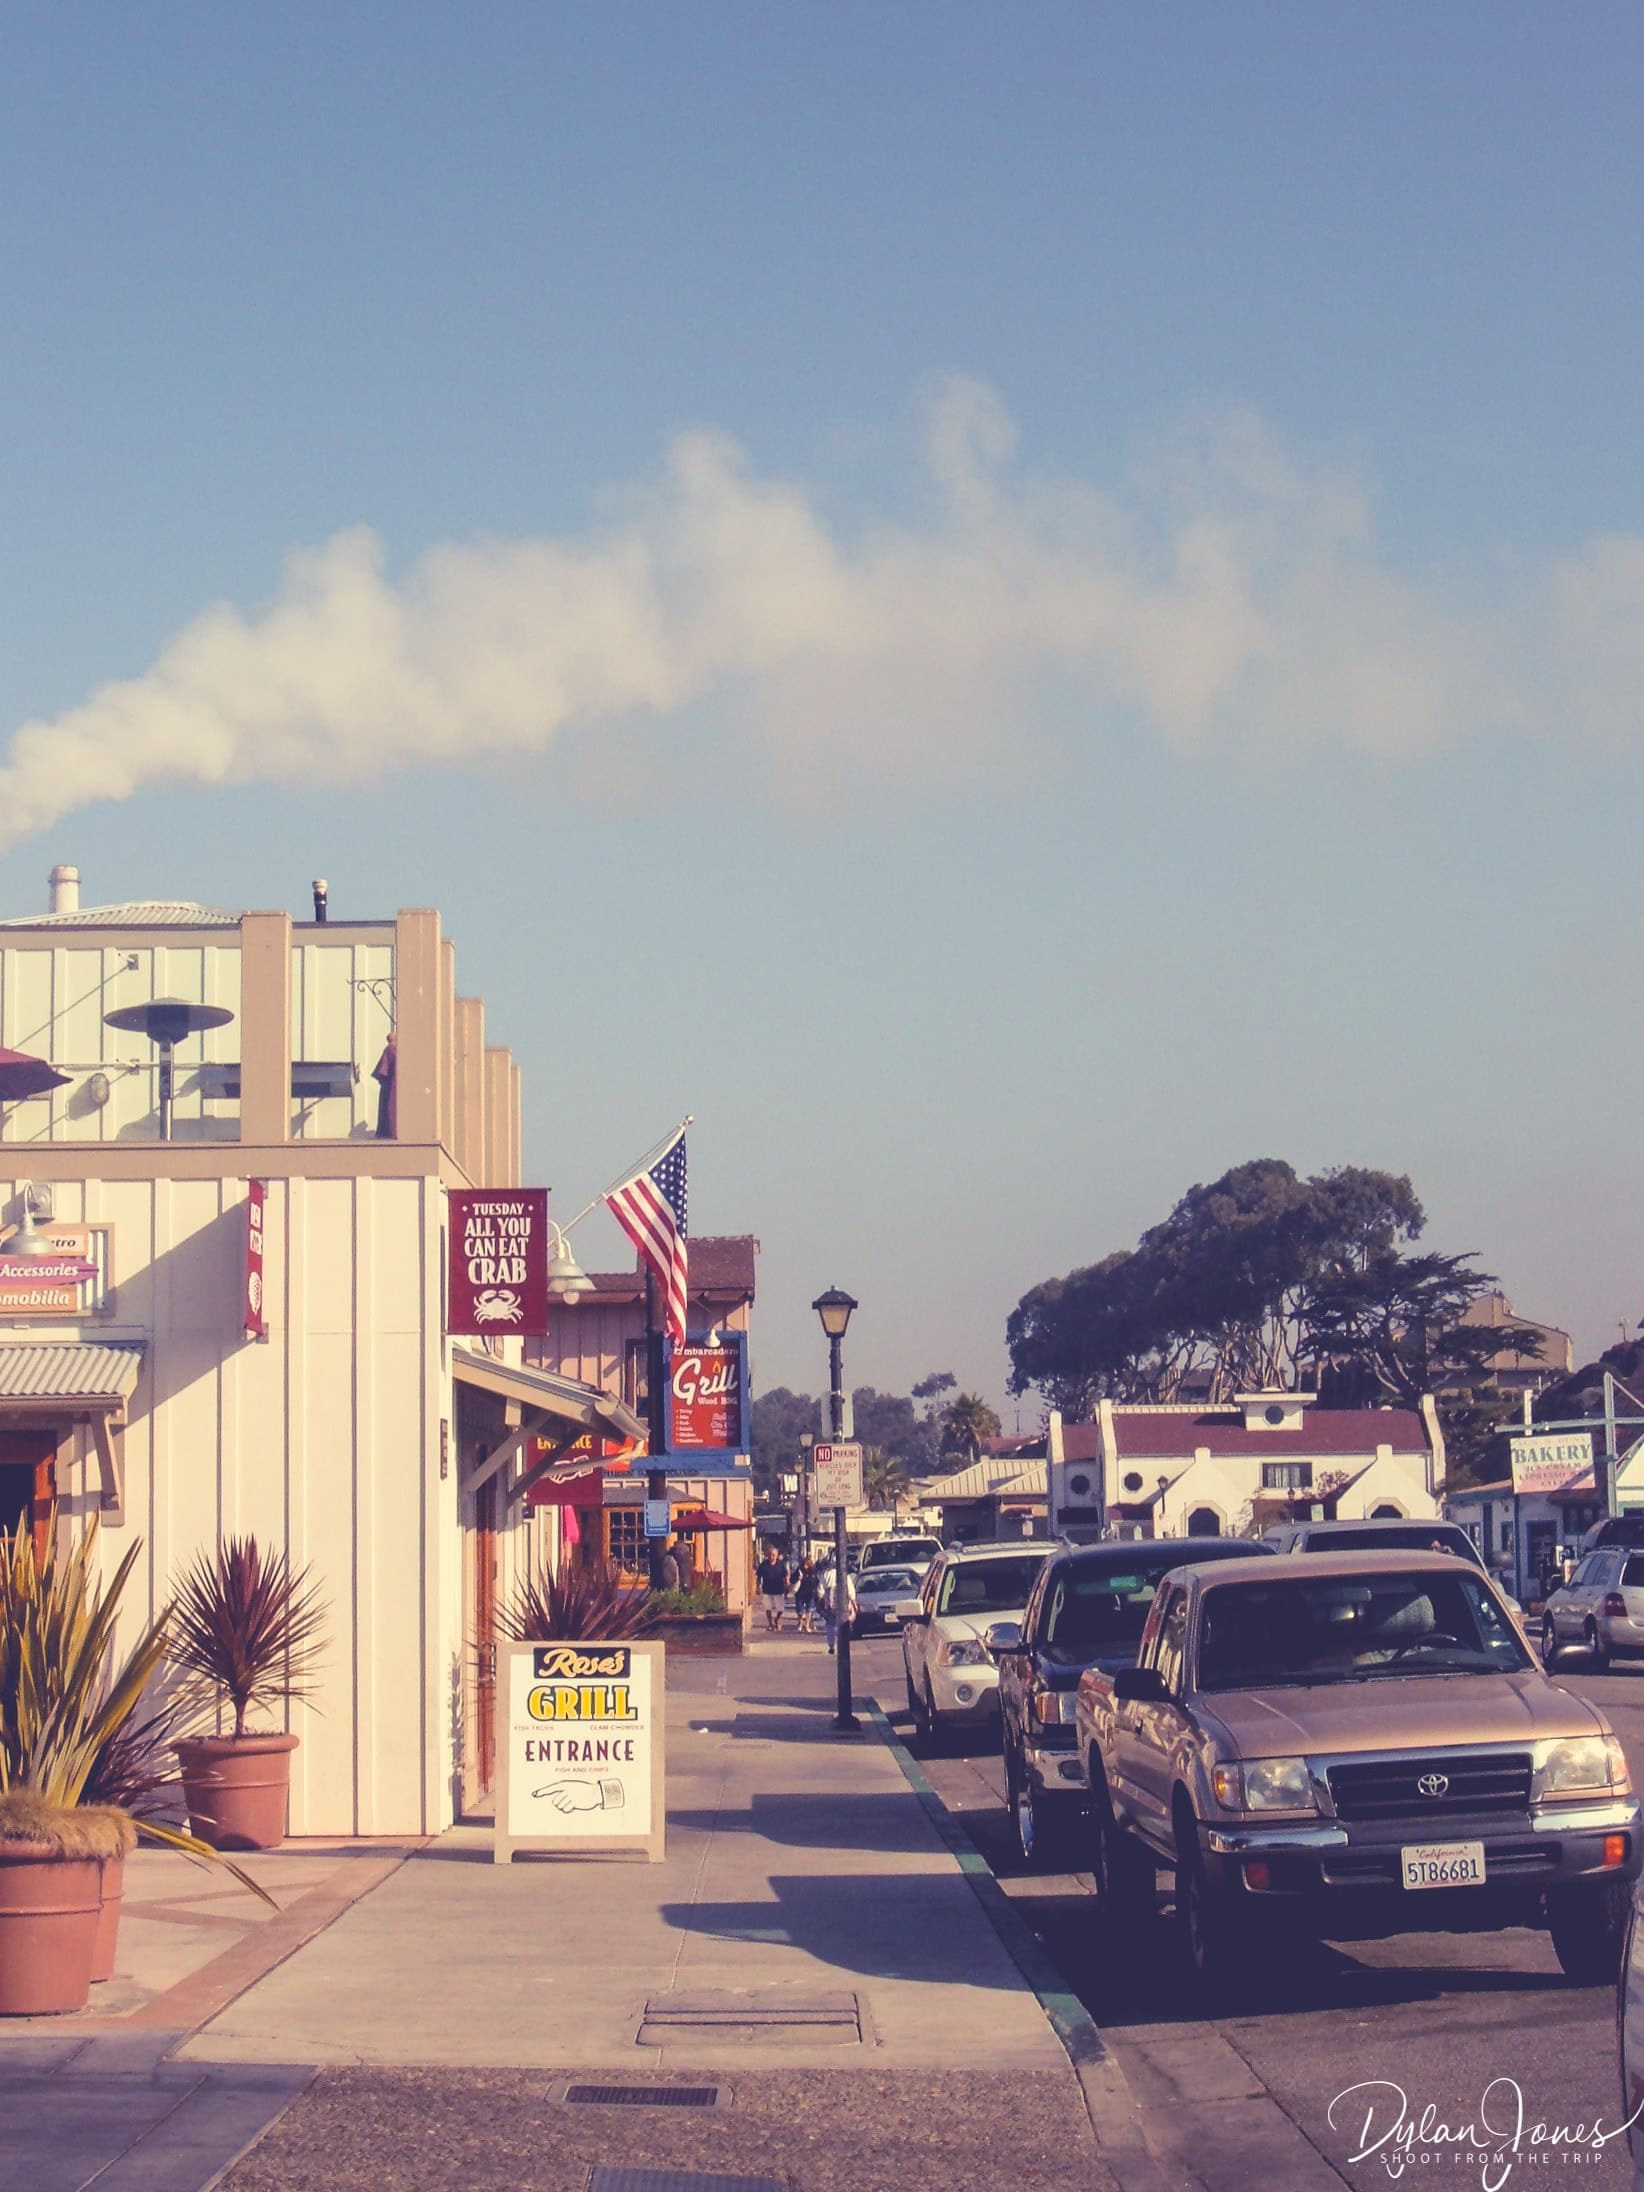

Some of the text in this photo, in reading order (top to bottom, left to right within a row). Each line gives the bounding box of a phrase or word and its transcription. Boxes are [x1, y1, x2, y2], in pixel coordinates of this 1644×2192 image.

[472, 1203, 524, 1216] TUESDAY
[464, 1217, 531, 1237] ALL YOU
[50, 1239, 77, 1248] tro
[464, 1237, 529, 1257] CAN EAT
[0, 1262, 79, 1277] Accessories
[468, 1257, 527, 1285] CRAB
[0, 1289, 70, 1305] mobilia
[673, 1358, 738, 1406] Grill
[818, 1447, 831, 1460] NO
[1512, 1444, 1590, 1464] BAKERY
[538, 1648, 625, 1678] Rose's
[527, 1685, 638, 1721] GRILL
[525, 1739, 635, 1762] ENTRANCE
[1420, 1848, 1467, 1859] California
[1407, 1859, 1480, 1882] 5T86681
